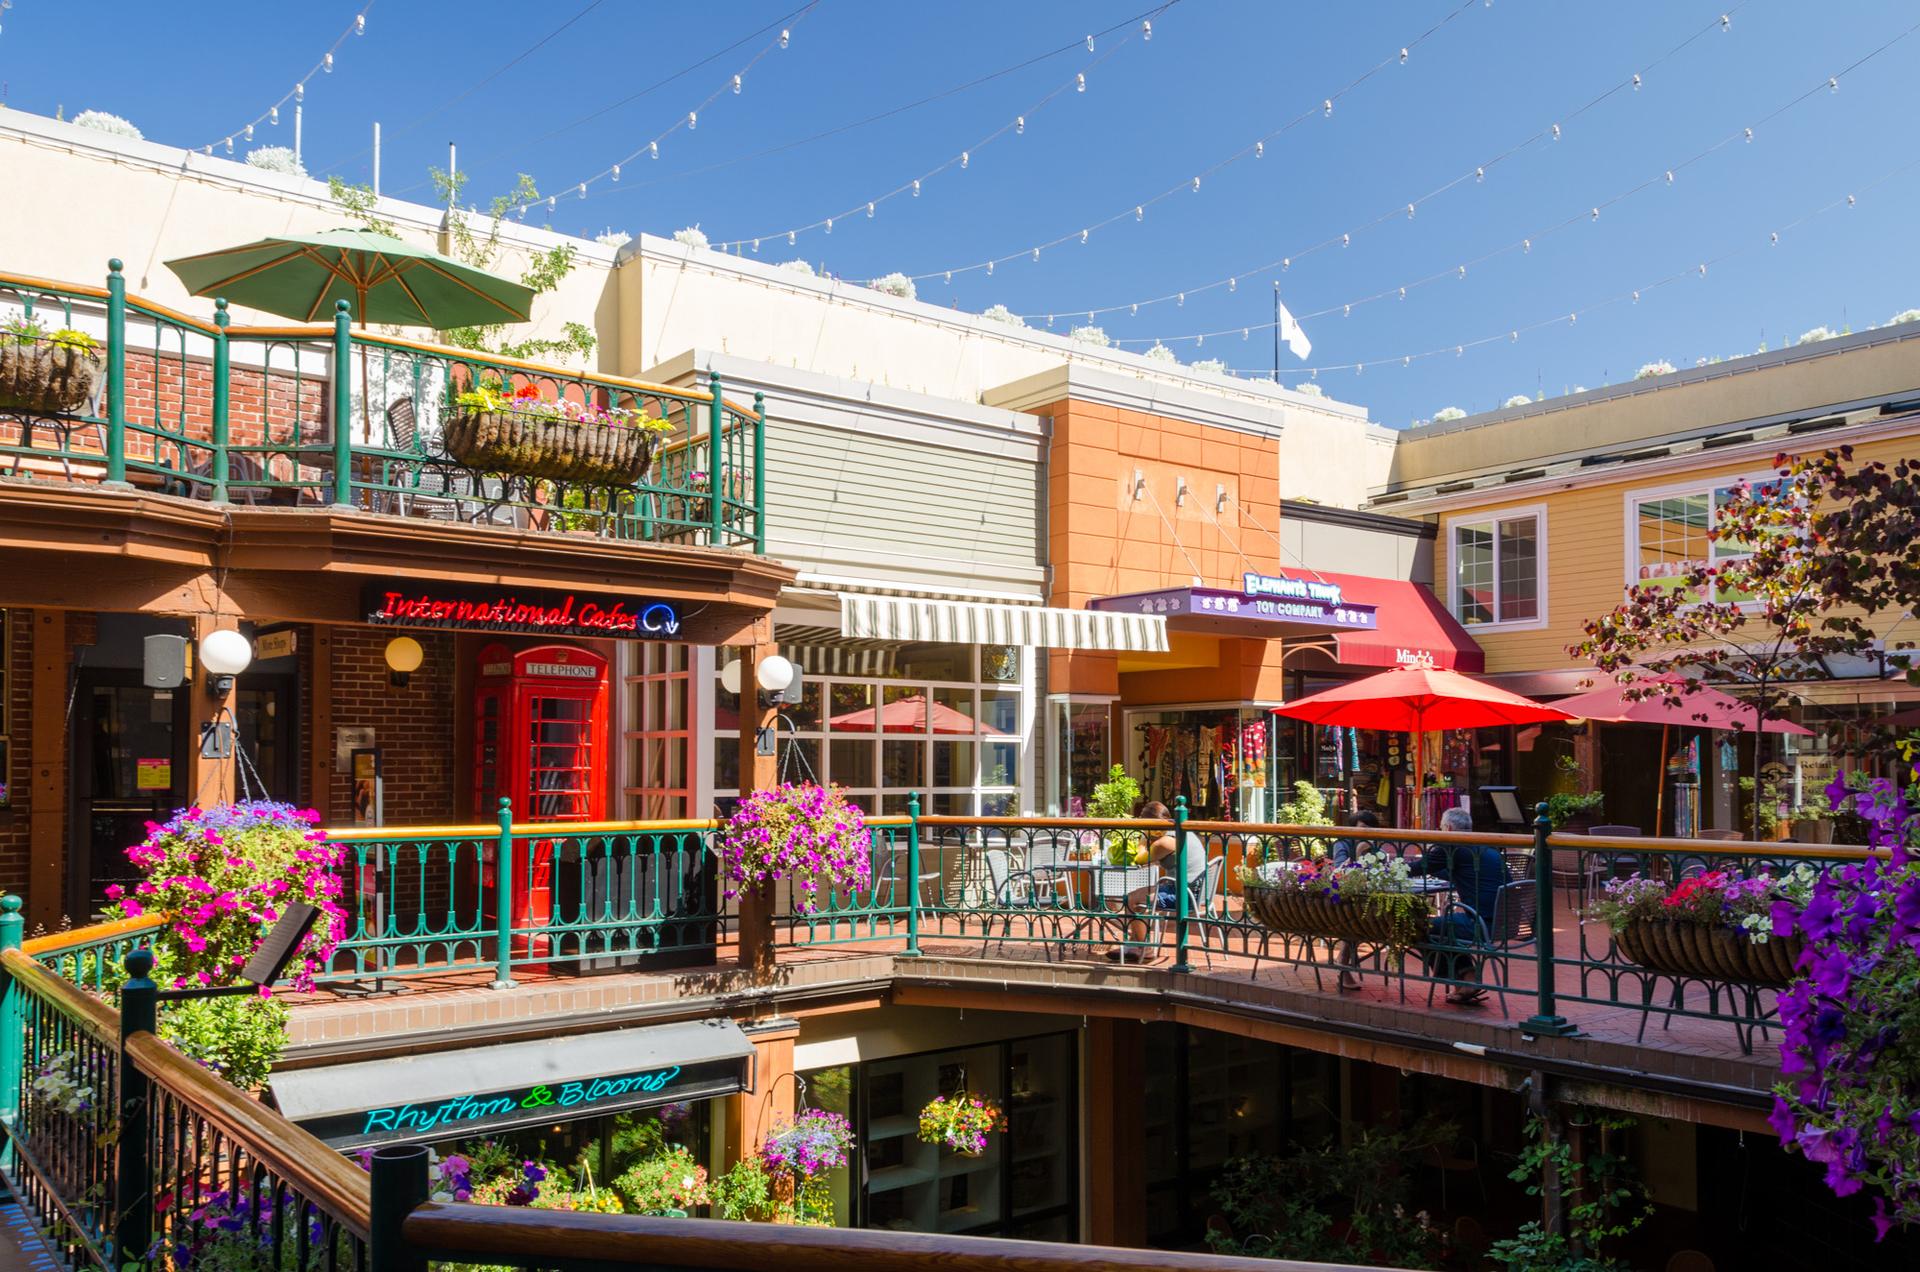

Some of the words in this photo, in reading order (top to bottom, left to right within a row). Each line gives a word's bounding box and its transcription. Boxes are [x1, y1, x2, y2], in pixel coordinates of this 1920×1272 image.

[383, 592, 575, 625] International
[578, 602, 638, 630] Cafes
[1256, 600, 1275, 615] TOY
[1277, 602, 1323, 618] COMPANY
[530, 664, 594, 677] TELEPHONE
[363, 1094, 517, 1134] Rhythm
[520, 1085, 556, 1108] &
[557, 1065, 680, 1106] Blooms
